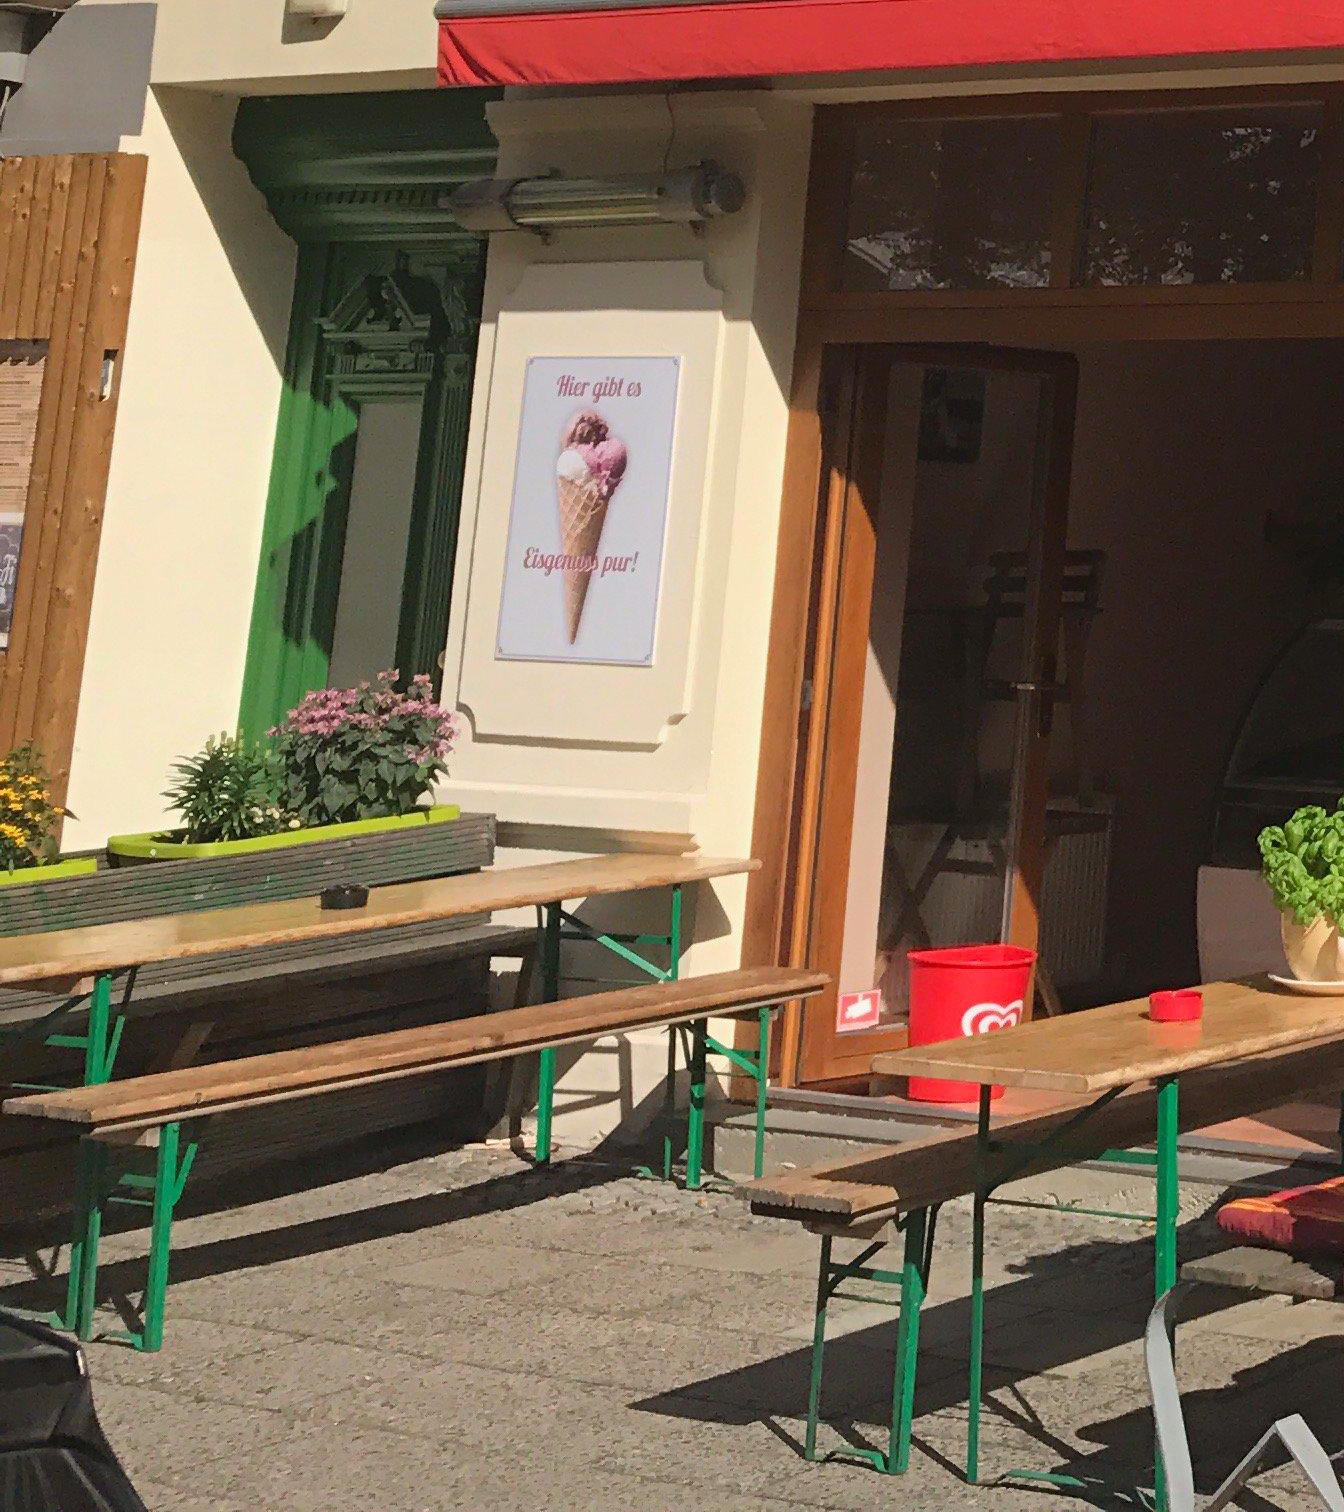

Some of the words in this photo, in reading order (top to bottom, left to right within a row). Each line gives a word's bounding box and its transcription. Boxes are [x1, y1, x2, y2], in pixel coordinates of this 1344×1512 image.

[557, 375, 589, 398] Hier
[592, 376, 623, 404] gibt
[627, 381, 642, 398] es
[523, 547, 598, 577] Eisgenuss
[601, 551, 638, 578] pur!
